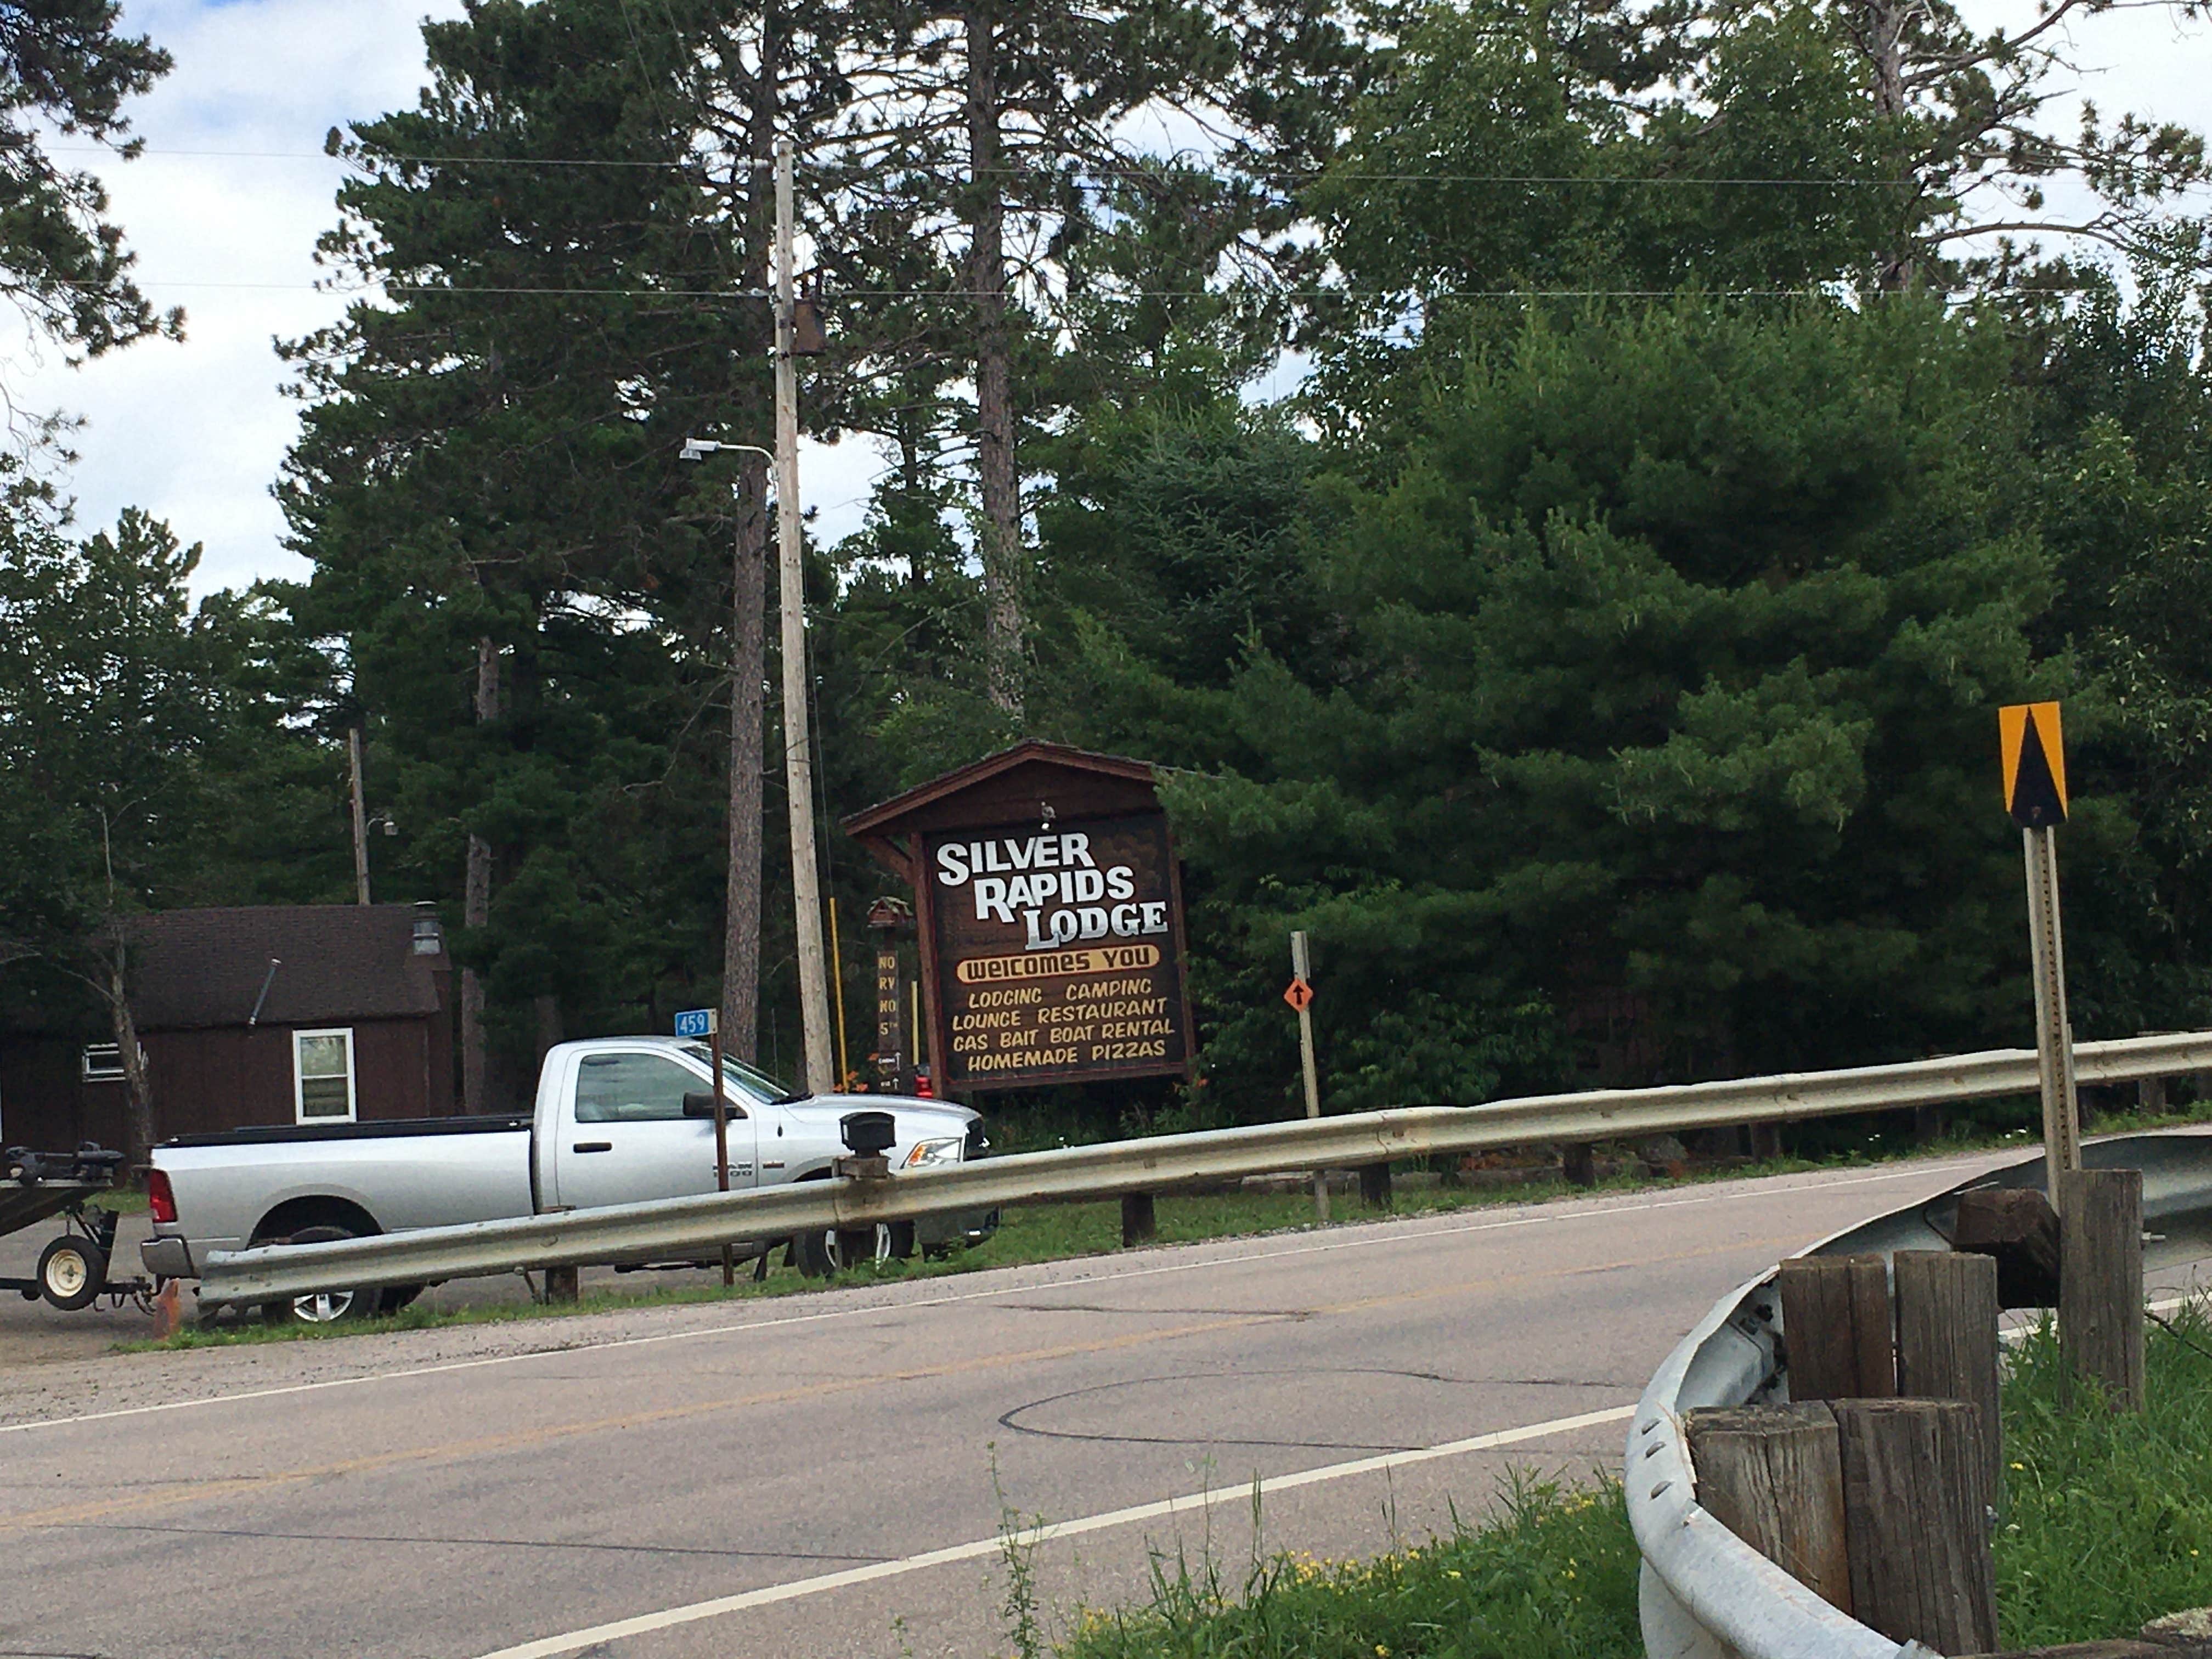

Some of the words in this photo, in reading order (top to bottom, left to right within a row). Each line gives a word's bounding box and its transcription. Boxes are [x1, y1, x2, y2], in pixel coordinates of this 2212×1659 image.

[937, 832, 1096, 886] SILVER
[974, 866, 1135, 923] RAPIDS
[1023, 901, 1169, 950] LODGE
[879, 956, 895, 969] NO
[1103, 947, 1150, 968] YOU
[879, 1000, 896, 1013] NO
[968, 988, 1042, 1009] LODGING
[1066, 978, 1152, 1001] CAMPING
[680, 1014, 705, 1034] 459
[952, 1010, 1021, 1031] LOUNGE
[1037, 997, 1167, 1024] RESTAURANT
[953, 1034, 988, 1052] GAS
[1000, 1029, 1039, 1048] BAIT
[1050, 1025, 1095, 1043] BOAT
[1102, 1018, 1176, 1039] RENTAL
[968, 1047, 1078, 1071] HOMEMADE
[1092, 1040, 1166, 1061] PIZZAS
